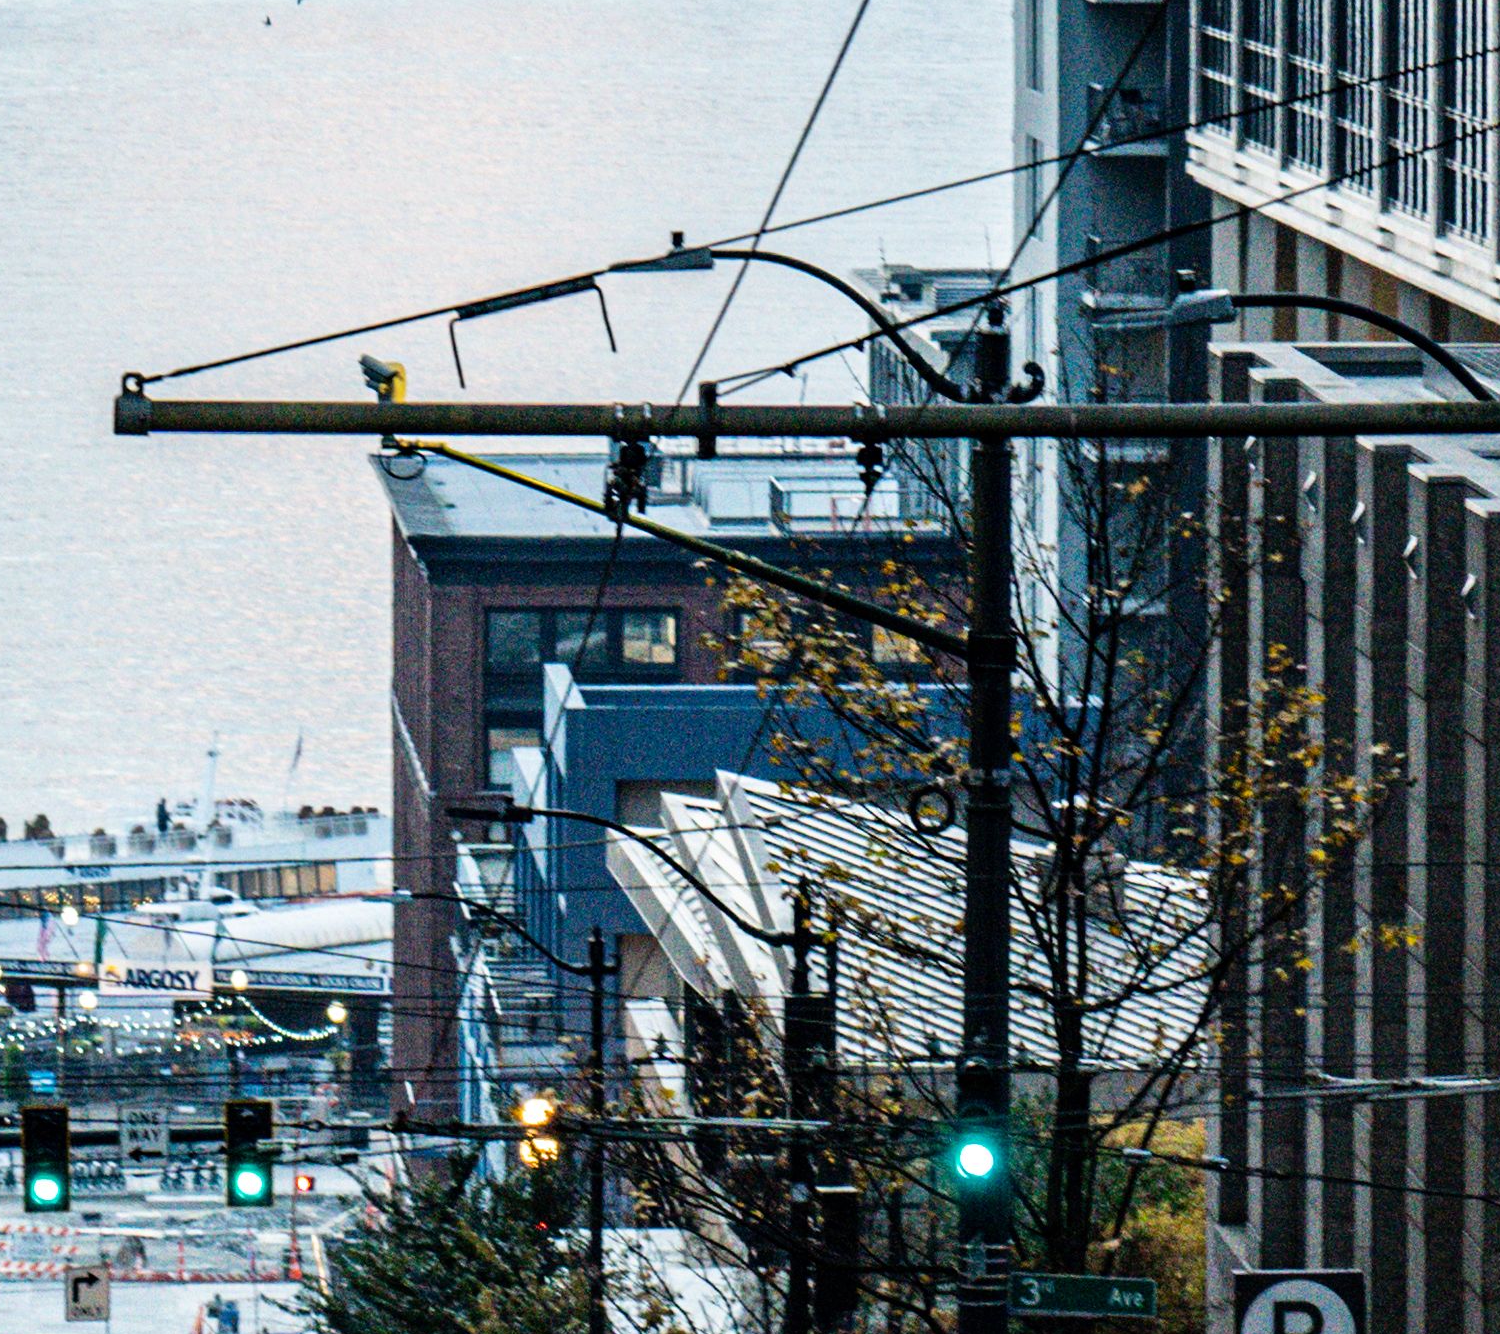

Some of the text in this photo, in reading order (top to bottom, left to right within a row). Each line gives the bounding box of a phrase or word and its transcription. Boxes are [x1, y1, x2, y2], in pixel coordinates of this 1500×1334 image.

[124, 968, 201, 990] ARGOSY
[128, 1113, 159, 1125] ONE
[128, 1128, 161, 1142] WAY
[1108, 1287, 1145, 1308] Ave
